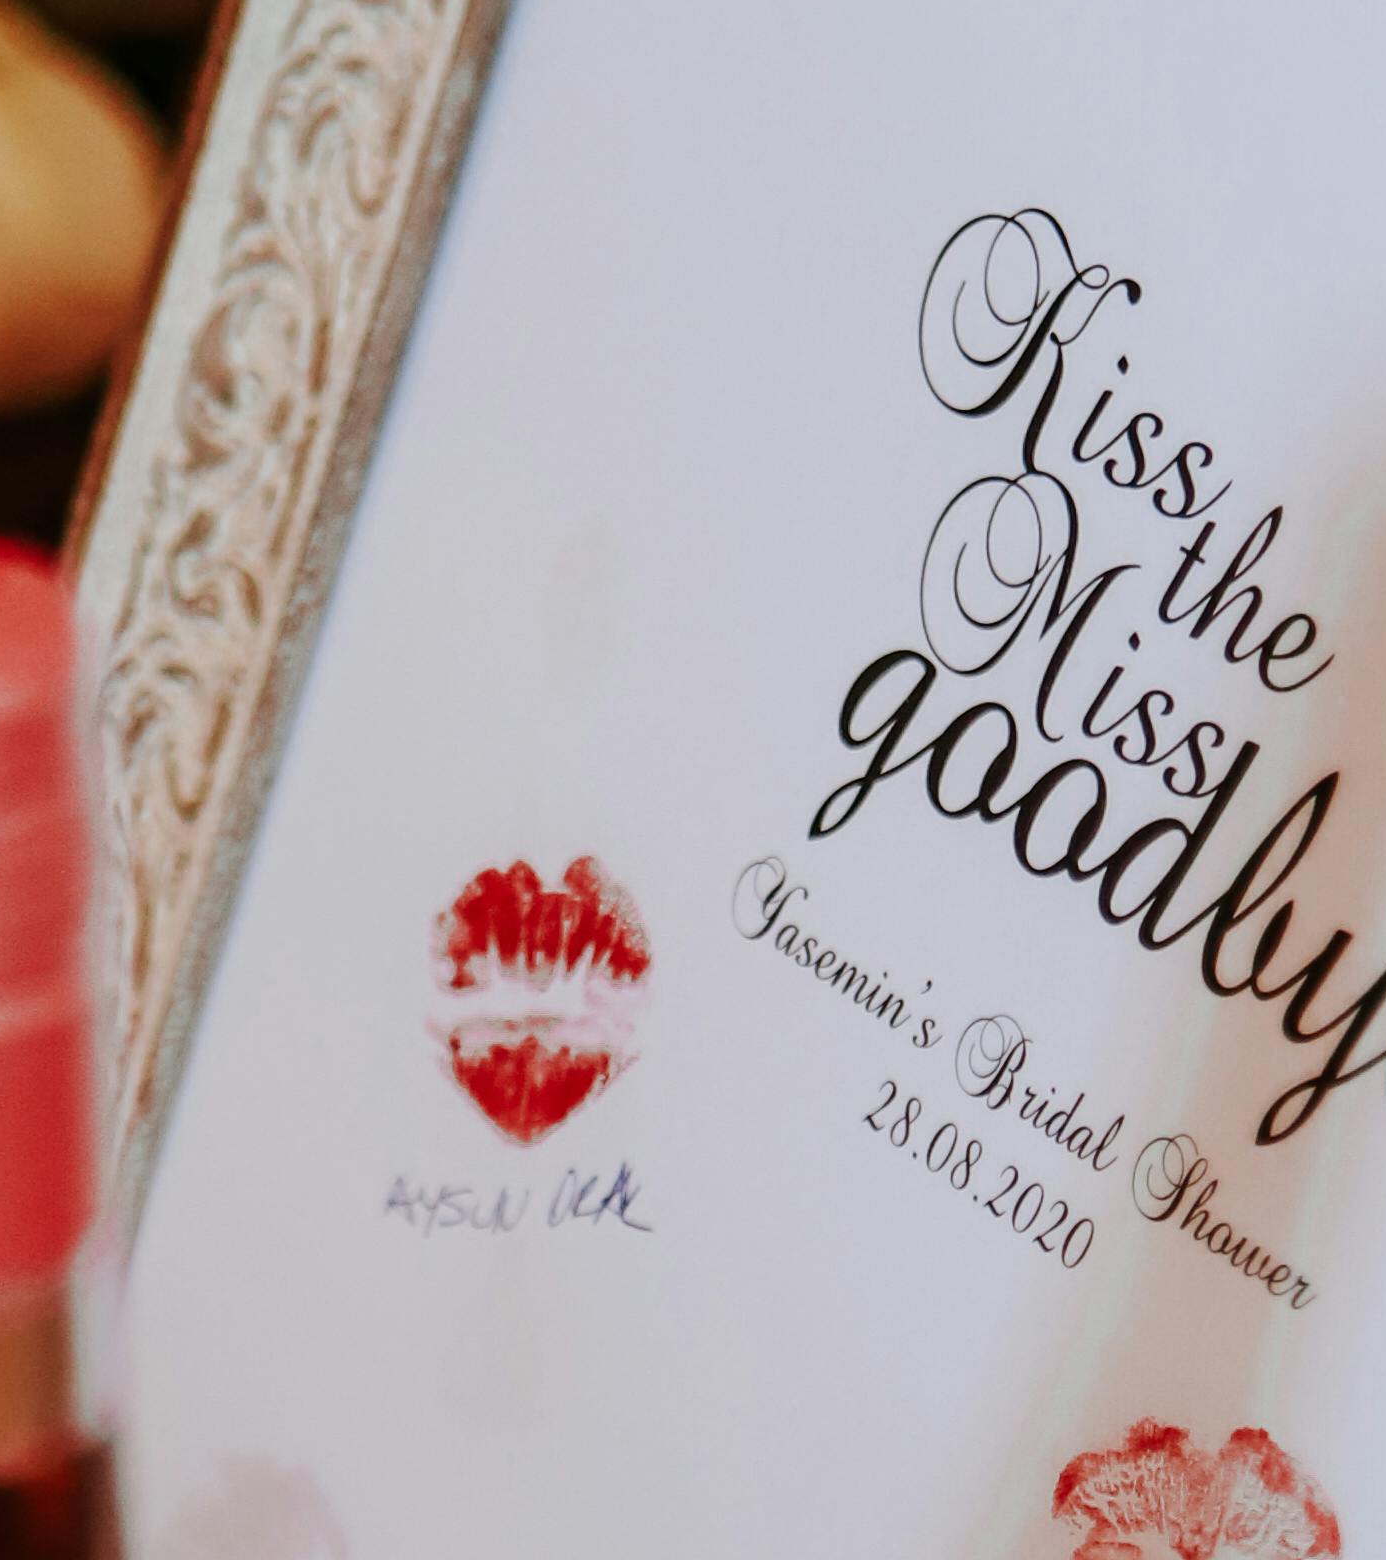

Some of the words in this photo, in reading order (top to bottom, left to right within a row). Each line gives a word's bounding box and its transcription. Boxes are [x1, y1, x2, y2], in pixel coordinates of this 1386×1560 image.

[919, 207, 1233, 520] Kiss
[920, 471, 1228, 798] Miss
[1157, 504, 1336, 692] the
[731, 854, 943, 1052] Yasemin's
[954, 1013, 1120, 1172] Bridal
[1131, 1132, 1319, 1313] Shower
[860, 1079, 1097, 1272] 28.08.2020
